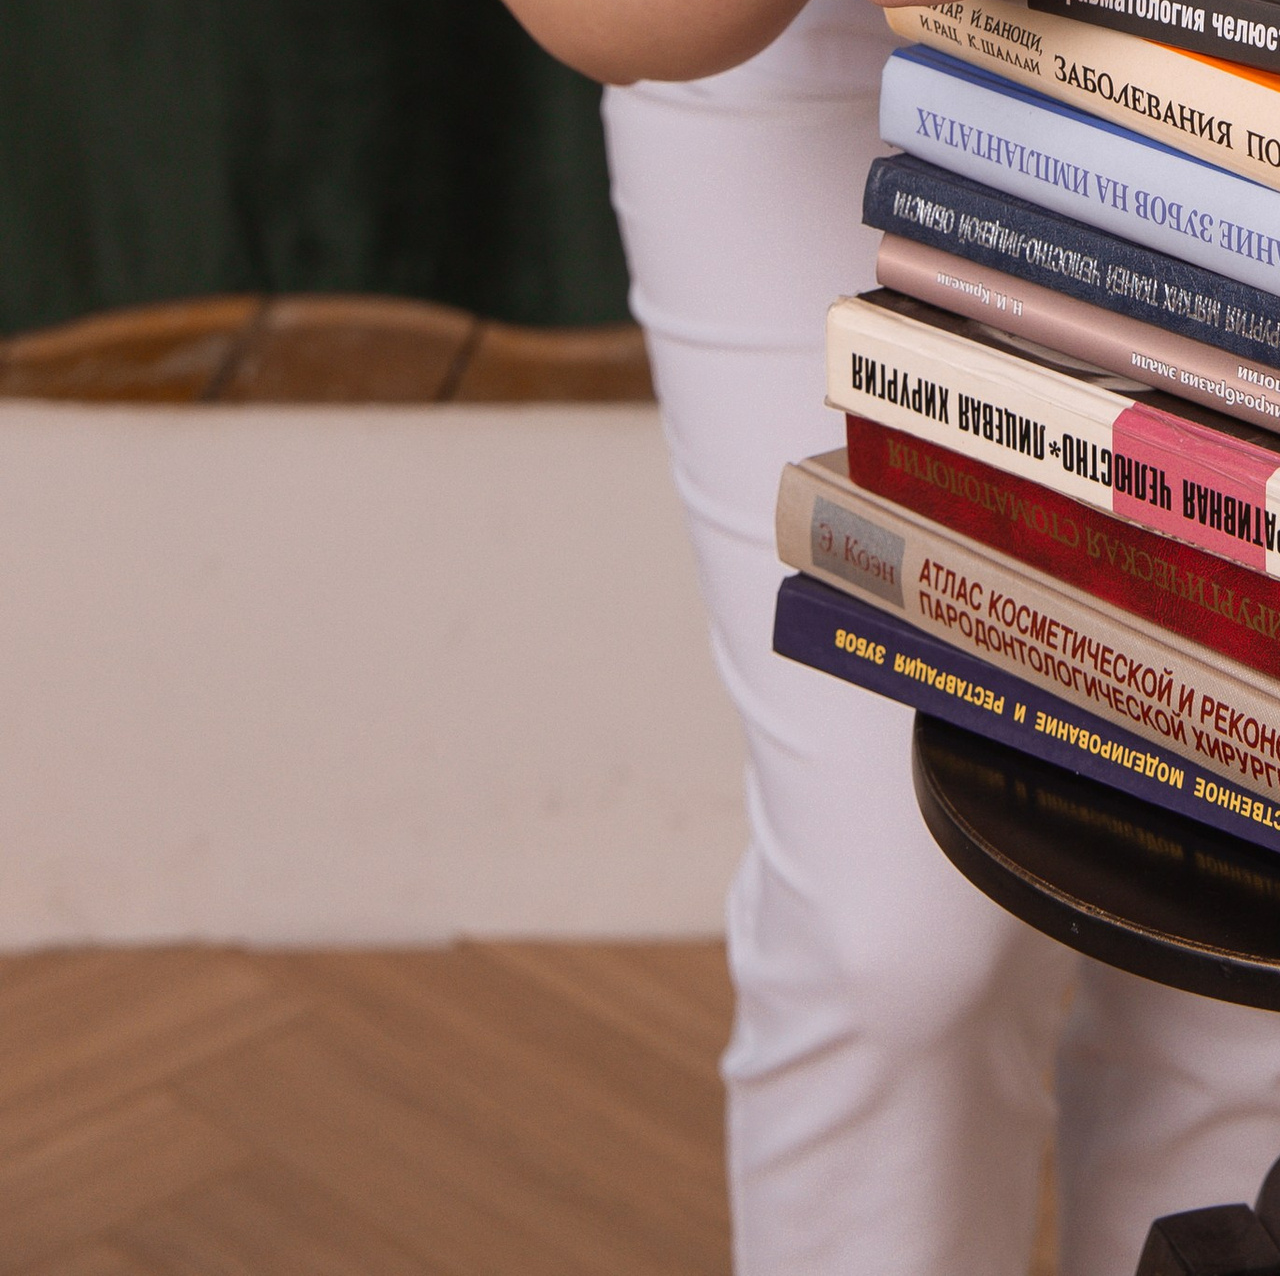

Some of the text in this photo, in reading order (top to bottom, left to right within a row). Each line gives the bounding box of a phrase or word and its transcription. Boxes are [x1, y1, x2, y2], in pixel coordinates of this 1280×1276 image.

[1053, 54, 1235, 150] ЗАБОЛЕВАНИЯ
[916, 107, 1091, 199] ИМПЛАНТАТАХ
[892, 191, 956, 234] ОБЛАСТИ
[1094, 173, 1130, 212] НА
[1134, 196, 1213, 244] ЗУБОВ
[958, 213, 1101, 287] ЧЕЛЮСТНО-ЛИЦЕВОЙ
[937, 271, 991, 305] Крихели
[1105, 264, 1159, 307] ТКАНЕЙ
[1164, 283, 1221, 328] МЯГКИХ
[851, 352, 950, 425] ХИРУРГИЯ
[1131, 352, 1178, 381] эмали
[886, 437, 1080, 548] СТОМАТОЛОГИЯ
[835, 628, 887, 665] ЗУБОВ
[919, 558, 984, 611] АТЛАС
[988, 589, 1174, 707] КОСМЕТИЧЕСКОЙ
[1178, 683, 1195, 718] И
[893, 652, 1005, 715] РЕСТАВРАЦИЯ
[918, 590, 1188, 746] ПАРОДОНТОЛОГИЧЕСКОЙ
[1013, 702, 1027, 724] И
[1034, 711, 1185, 789] МОДЕЛИРОВАНИЕ
